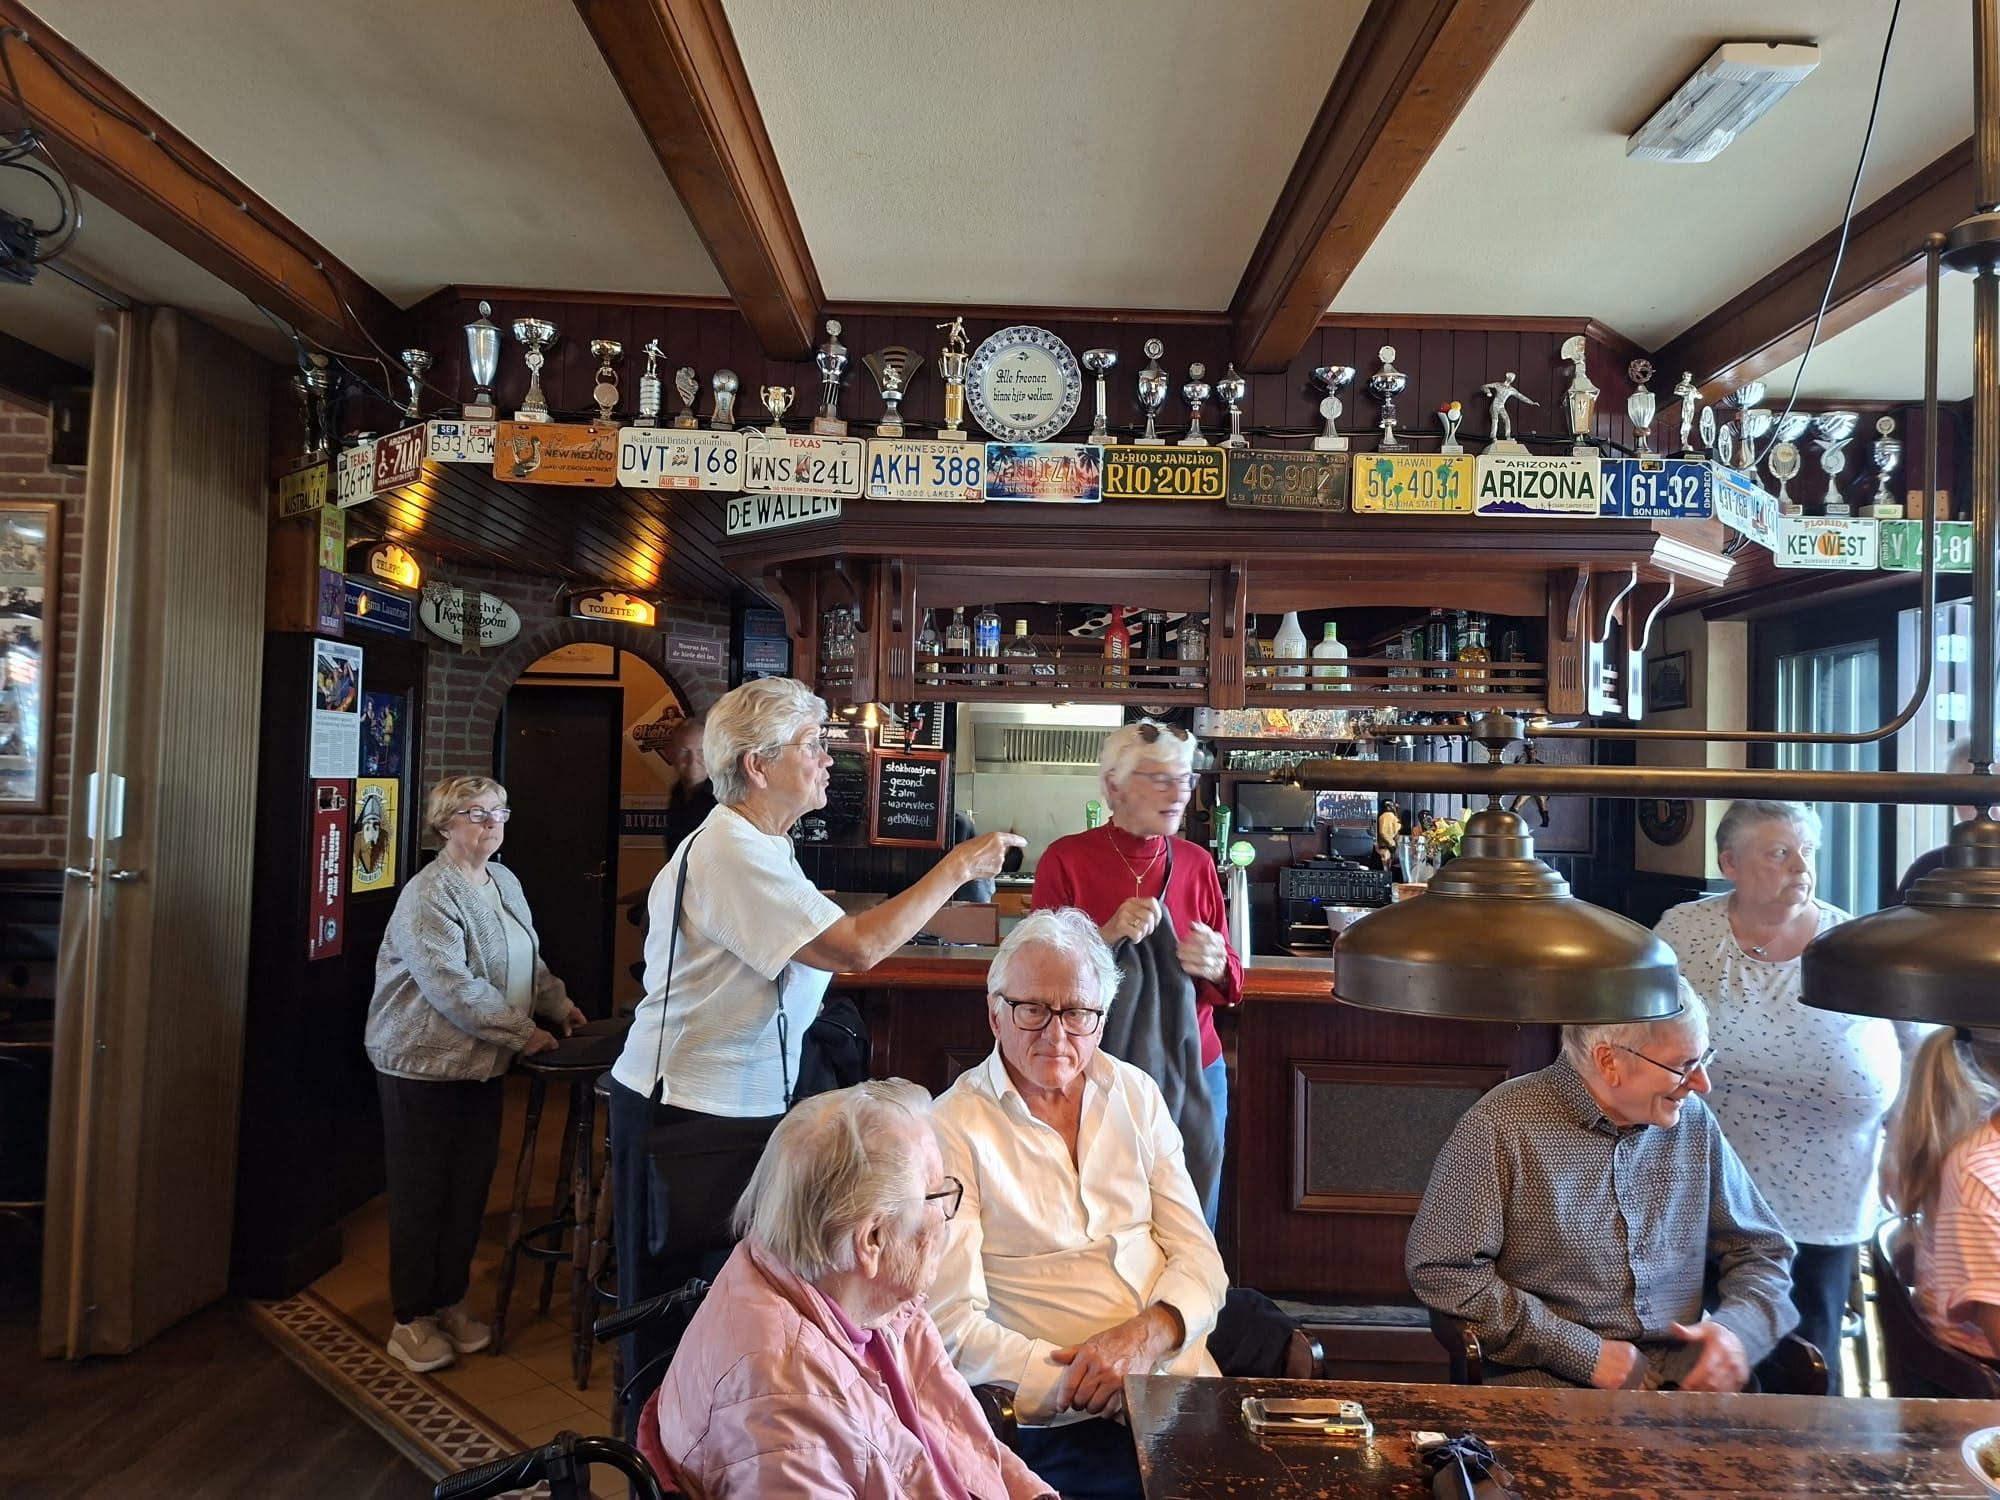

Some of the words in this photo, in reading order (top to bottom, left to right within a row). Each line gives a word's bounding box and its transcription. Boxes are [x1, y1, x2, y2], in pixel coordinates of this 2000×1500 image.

[440, 425, 456, 434] SEP
[389, 433, 412, 447] ARIZONA
[431, 435, 461, 453] 633
[630, 435, 666, 445] Beautiful
[667, 436, 692, 445] British
[693, 437, 732, 447] Columbia
[787, 438, 822, 449] TEXAS
[544, 449, 570, 460] NEW
[571, 449, 613, 462] MEXICO
[895, 444, 959, 454] MINNESOTA
[350, 451, 369, 469] TEXAS
[622, 444, 669, 473] DVT
[694, 447, 738, 475] 168
[1150, 454, 1162, 463] DE
[1163, 454, 1214, 465] JANEIRO
[1397, 458, 1432, 468] HAWAII
[1506, 461, 1568, 469] ARIZONA
[751, 456, 791, 482] WNS
[813, 459, 854, 485] 24L
[871, 453, 920, 486] AKH
[931, 455, 981, 487] 388
[1011, 456, 1078, 483] IBIZA
[338, 468, 356, 500] 126
[661, 477, 675, 486] AUG
[1480, 469, 1595, 500] ARIZONA
[927, 490, 955, 498] LAKES
[1601, 473, 1617, 505] K
[1631, 473, 1700, 509] 61-32
[285, 488, 320, 514] AUSTRALIA
[1253, 494, 1277, 503] WEST
[1280, 495, 1320, 506] VIRGINIA
[1415, 501, 1438, 509] STATE
[729, 501, 752, 530] DE
[757, 495, 838, 525] WALLEN
[1633, 508, 1652, 516] BON
[1653, 508, 1671, 516] BINI
[1803, 519, 1849, 530] FLORIDA
[1787, 535, 1818, 555] KEY
[1823, 535, 1867, 557] WEST
[470, 601, 503, 615] echte
[588, 604, 639, 618] TOILETTEN
[453, 624, 494, 639] kroket
[1112, 636, 1122, 660] SHOT
[890, 777, 925, 791] gezond
